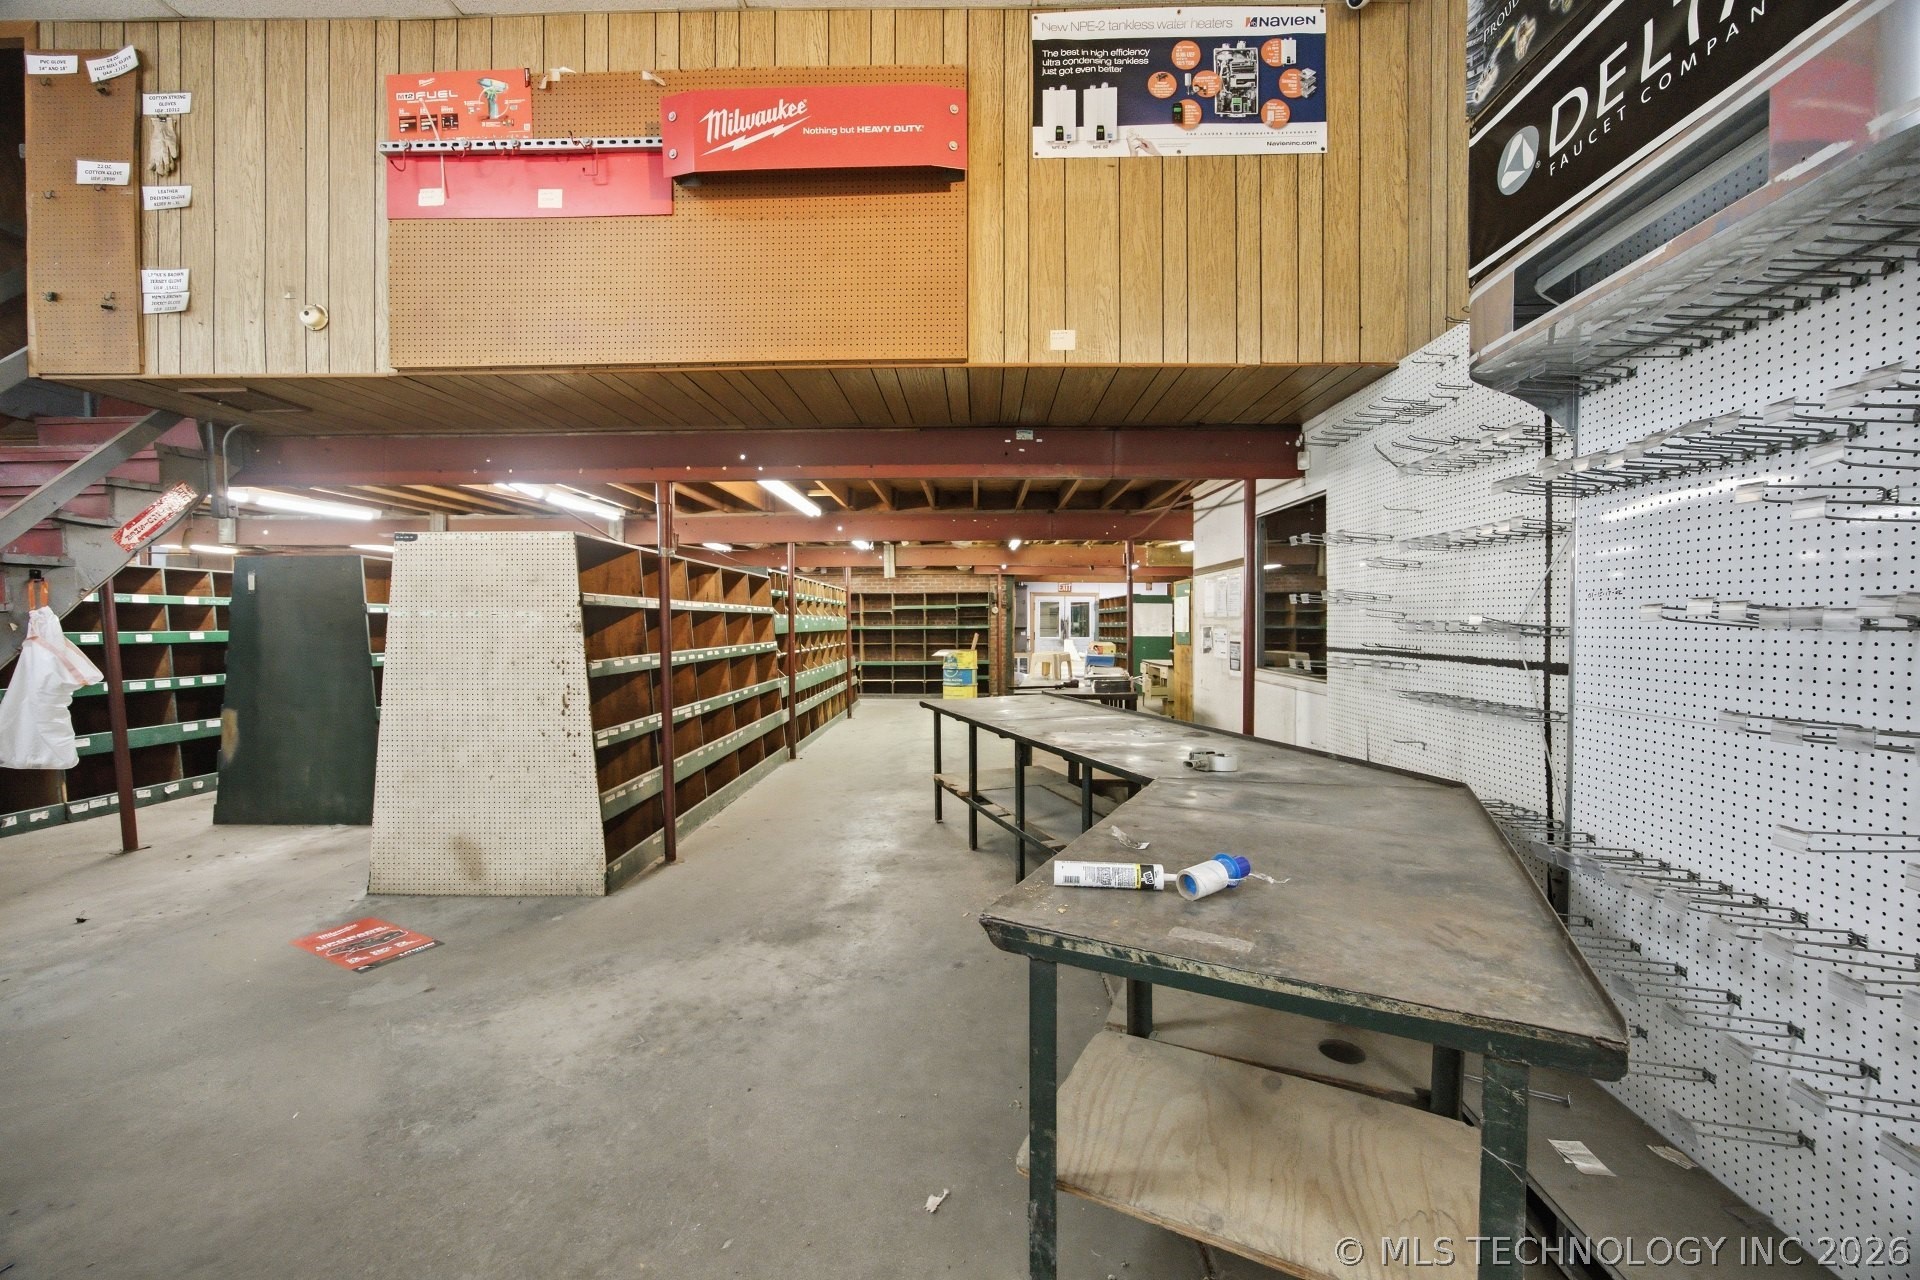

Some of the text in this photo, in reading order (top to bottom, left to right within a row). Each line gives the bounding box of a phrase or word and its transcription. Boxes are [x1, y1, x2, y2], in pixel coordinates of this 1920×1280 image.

[1042, 17, 1233, 32] New NPE-2 tankless water heaters
[1042, 49, 1058, 57] The
[1060, 48, 1080, 56] best
[1090, 49, 1109, 58] high
[1110, 48, 1150, 57] efficiency
[1042, 56, 1149, 67] ultra condensing tankless
[1042, 67, 1057, 76] just
[1058, 67, 1074, 77] got
[1098, 65, 1123, 73] better
[1549, 0, 1735, 157] DELT
[415, 90, 459, 100] FUEL
[699, 99, 808, 144] Milwaukee
[803, 121, 838, 135] Nothing
[857, 125, 891, 133] HEAVY
[1550, 105, 1626, 176] FAUCET
[1058, 583, 1071, 591] EXIT
